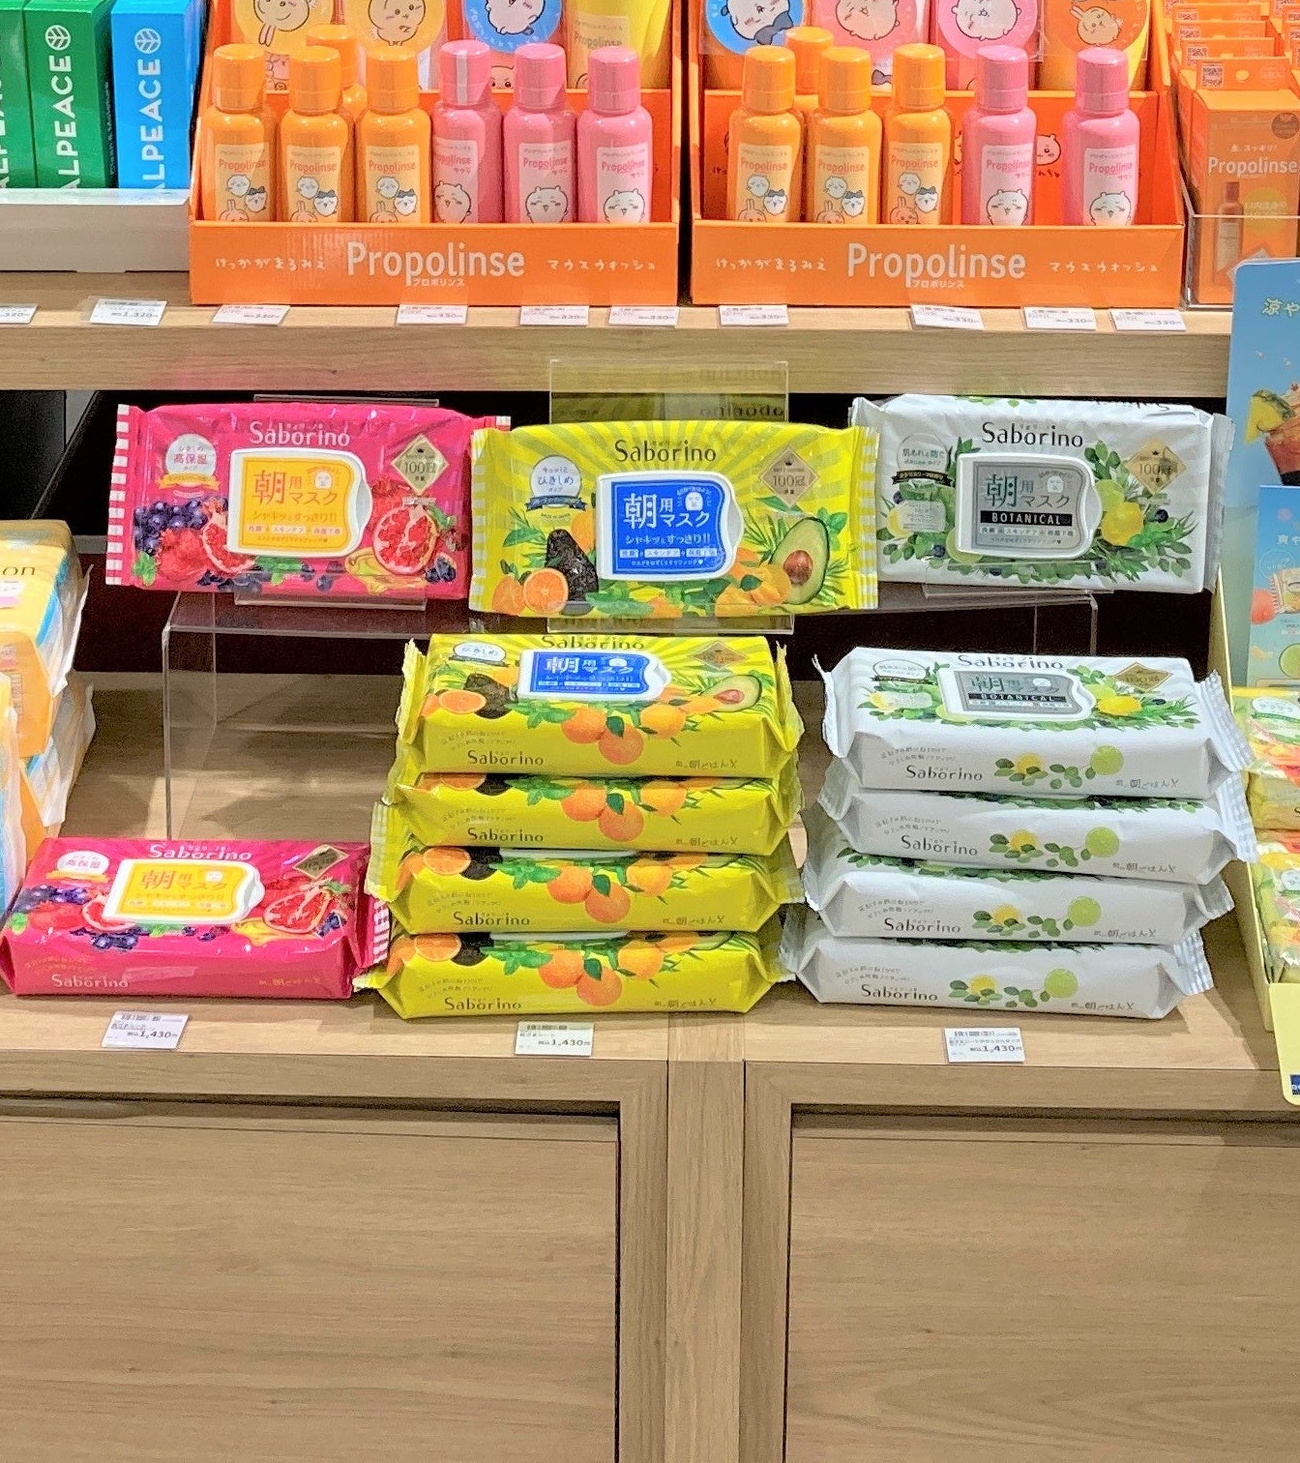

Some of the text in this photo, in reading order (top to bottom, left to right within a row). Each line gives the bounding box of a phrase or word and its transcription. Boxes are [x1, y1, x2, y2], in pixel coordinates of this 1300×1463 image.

[219, 158, 268, 172] Propolinse
[740, 159, 789, 173] Propolinse
[818, 161, 866, 175] Propolinse
[1207, 157, 1298, 177] Propolinse
[346, 241, 525, 287] Propolinse
[847, 243, 1027, 288] Propolinse
[249, 421, 351, 447] Saborino
[982, 421, 1084, 448] Saborino
[614, 439, 717, 463] Saborino
[537, 475, 574, 487] ひきしめ
[991, 512, 1061, 525] BOTANICAL
